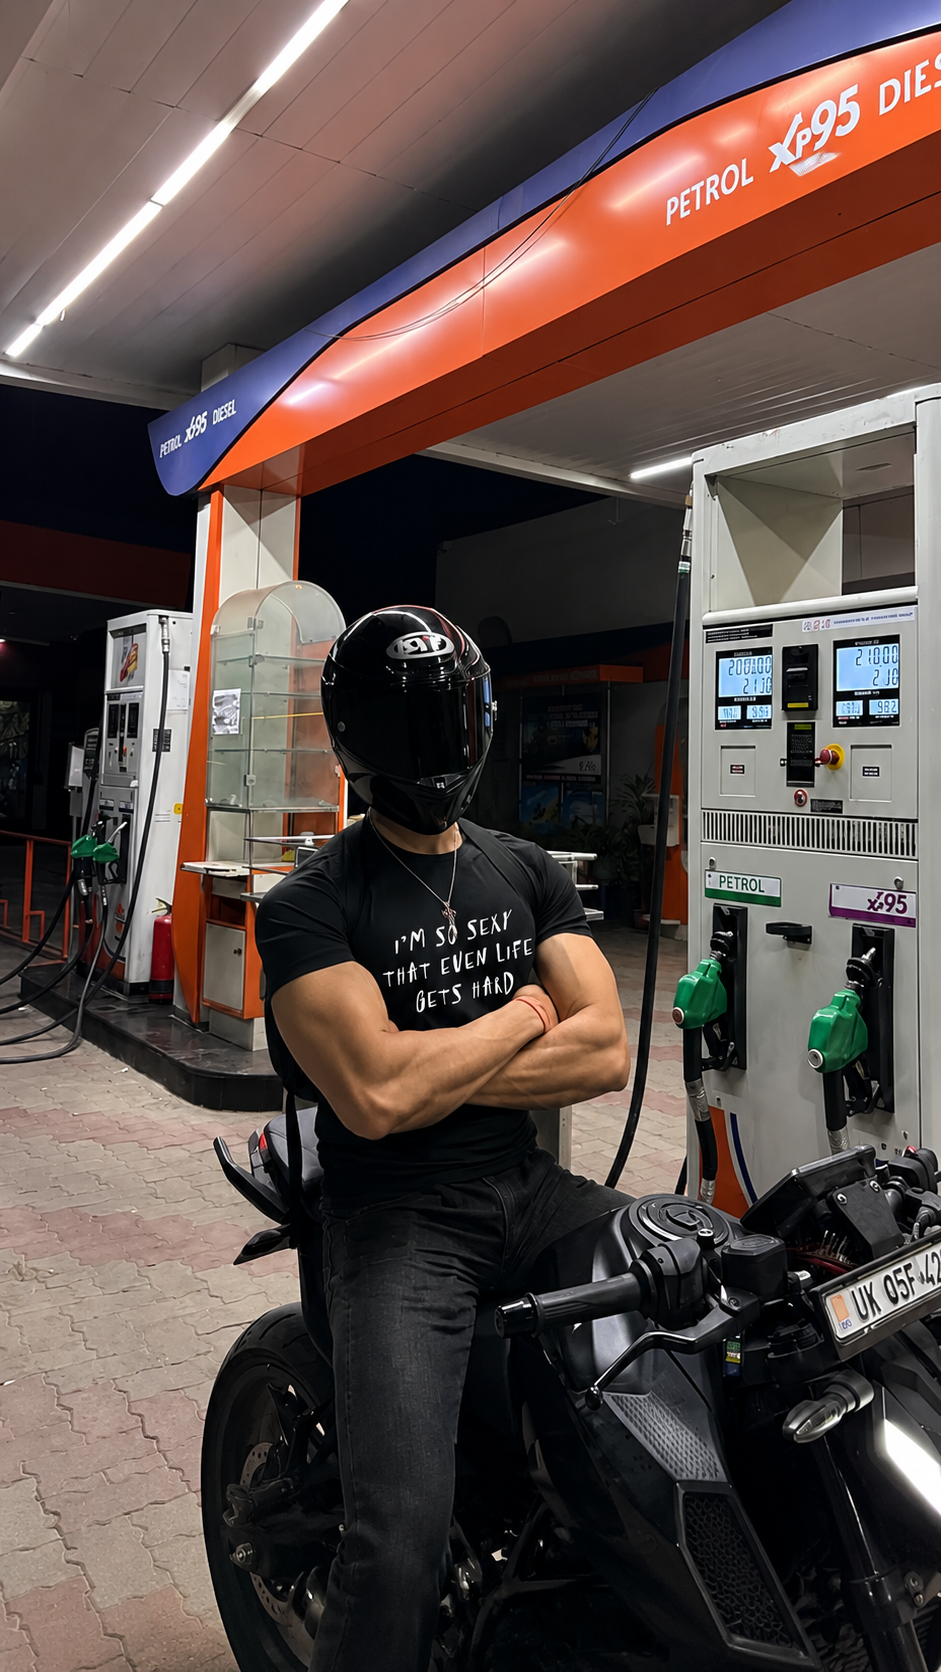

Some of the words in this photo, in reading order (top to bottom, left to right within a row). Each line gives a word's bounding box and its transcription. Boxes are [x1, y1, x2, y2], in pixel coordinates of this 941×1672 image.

[666, 158, 754, 226] PETROL
[212, 399, 237, 425] DIESEL
[719, 874, 765, 893] PETROL
[394, 928, 426, 955] I'M
[435, 924, 458, 947] SO
[467, 908, 513, 941] SEXY
[382, 961, 431, 988] THAT
[440, 947, 488, 975] EVEN
[495, 938, 533, 963] LIFE
[415, 983, 463, 1013] GETS
[471, 971, 514, 999] HARD
[851, 1281, 882, 1320] UK
[883, 1262, 916, 1305] 05F
[924, 1250, 941, 1286] 42
